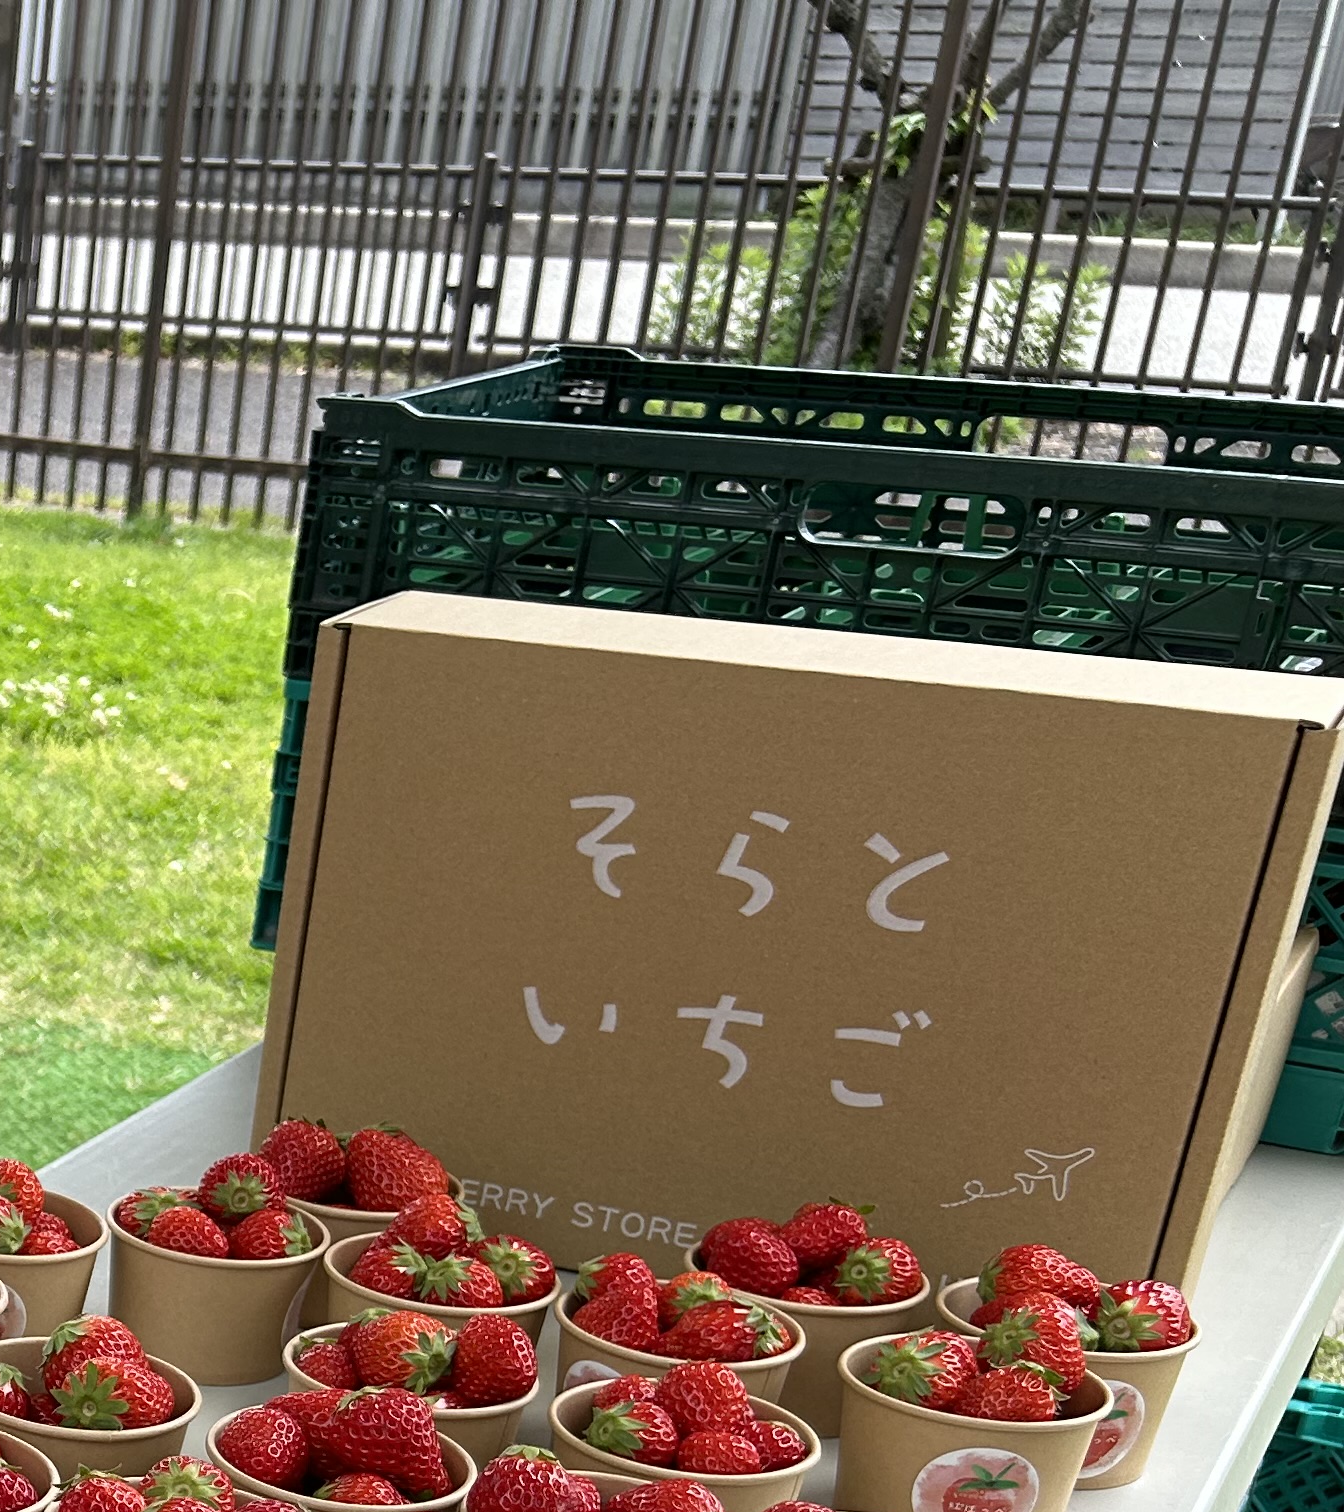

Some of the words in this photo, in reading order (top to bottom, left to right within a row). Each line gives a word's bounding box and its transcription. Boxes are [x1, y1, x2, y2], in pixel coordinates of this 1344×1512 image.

[570, 794, 951, 933] そらと
[522, 985, 932, 1107] いちご
[571, 1201, 697, 1248] STORE
